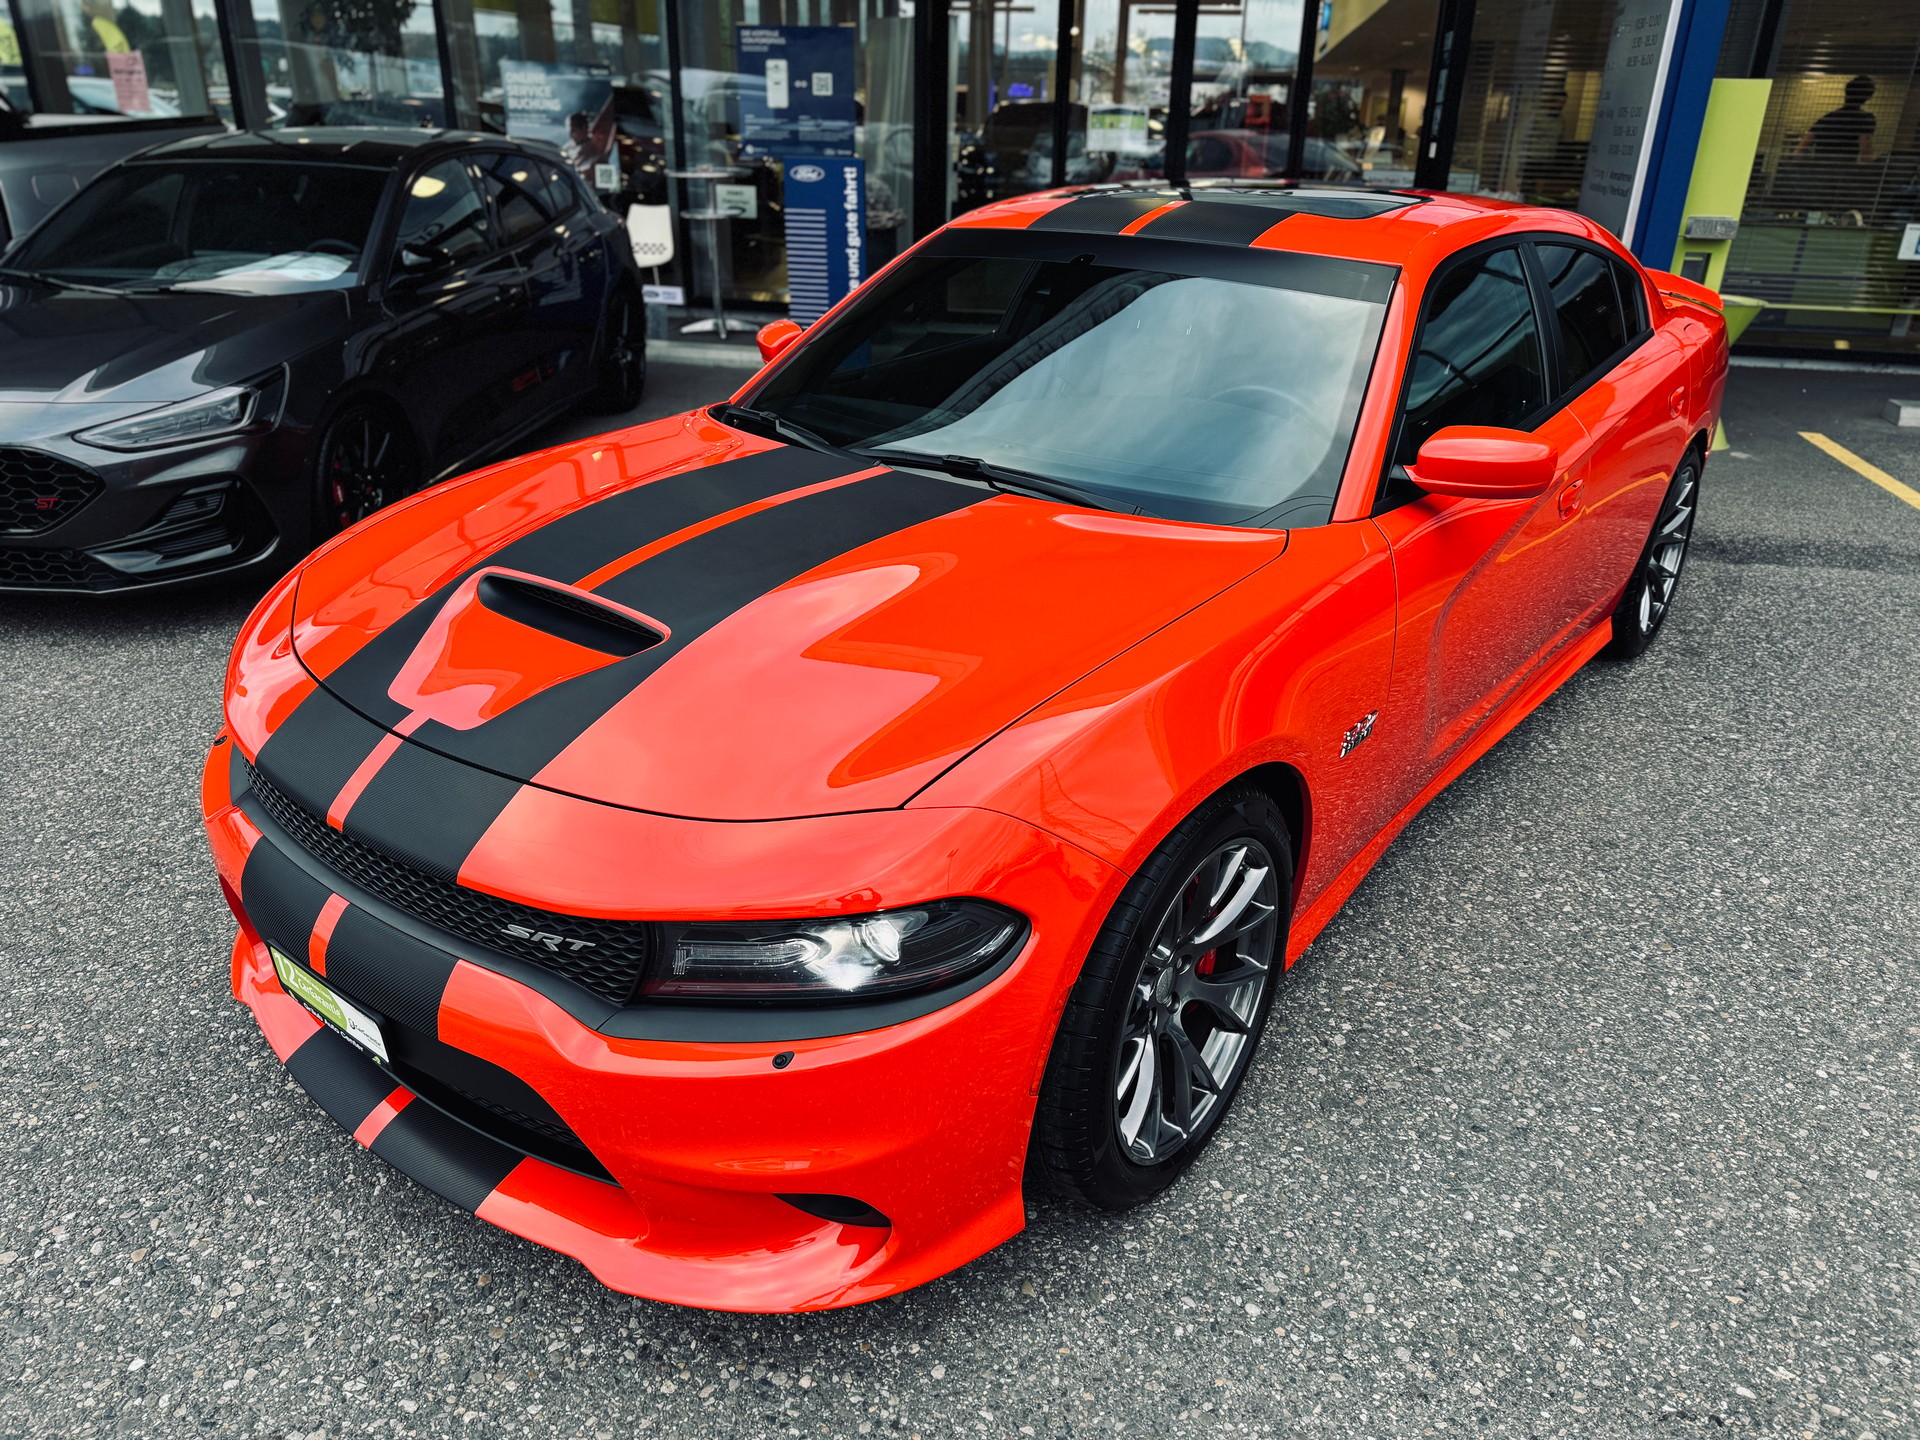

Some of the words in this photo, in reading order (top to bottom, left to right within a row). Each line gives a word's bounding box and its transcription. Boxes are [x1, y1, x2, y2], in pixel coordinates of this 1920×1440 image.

[505, 72, 546, 83] ONLINE
[506, 85, 552, 97] SERVICE
[508, 98, 561, 111] BUCHUNG
[843, 166, 858, 211] fahrt!
[845, 211, 862, 248] gute
[845, 247, 860, 278] und
[36, 497, 59, 509] ST
[501, 924, 596, 952] SRT
[273, 952, 300, 989] 12
[340, 1031, 363, 1052] Center
